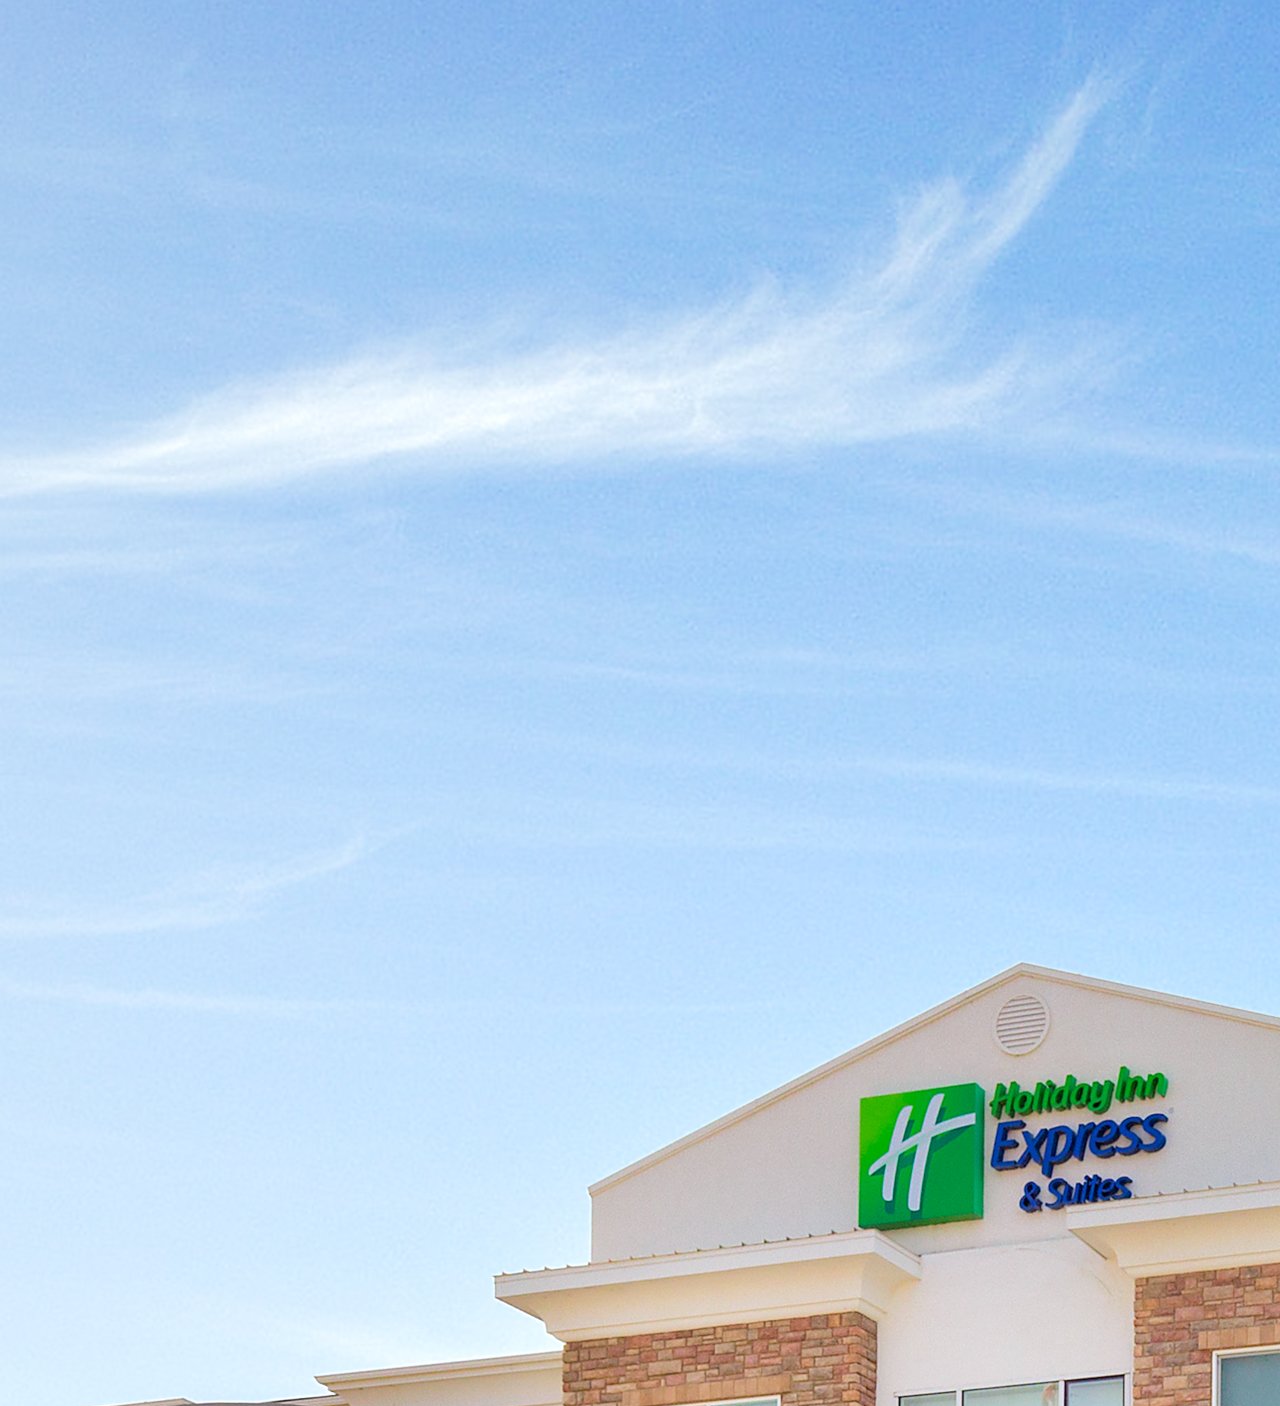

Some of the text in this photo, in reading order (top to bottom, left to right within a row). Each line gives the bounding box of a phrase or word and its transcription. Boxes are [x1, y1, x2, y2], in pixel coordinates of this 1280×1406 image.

[990, 1066, 1168, 1119] Holiday Inn
[991, 1113, 1168, 1178] Express
[1019, 1174, 1133, 1213] & Suites
